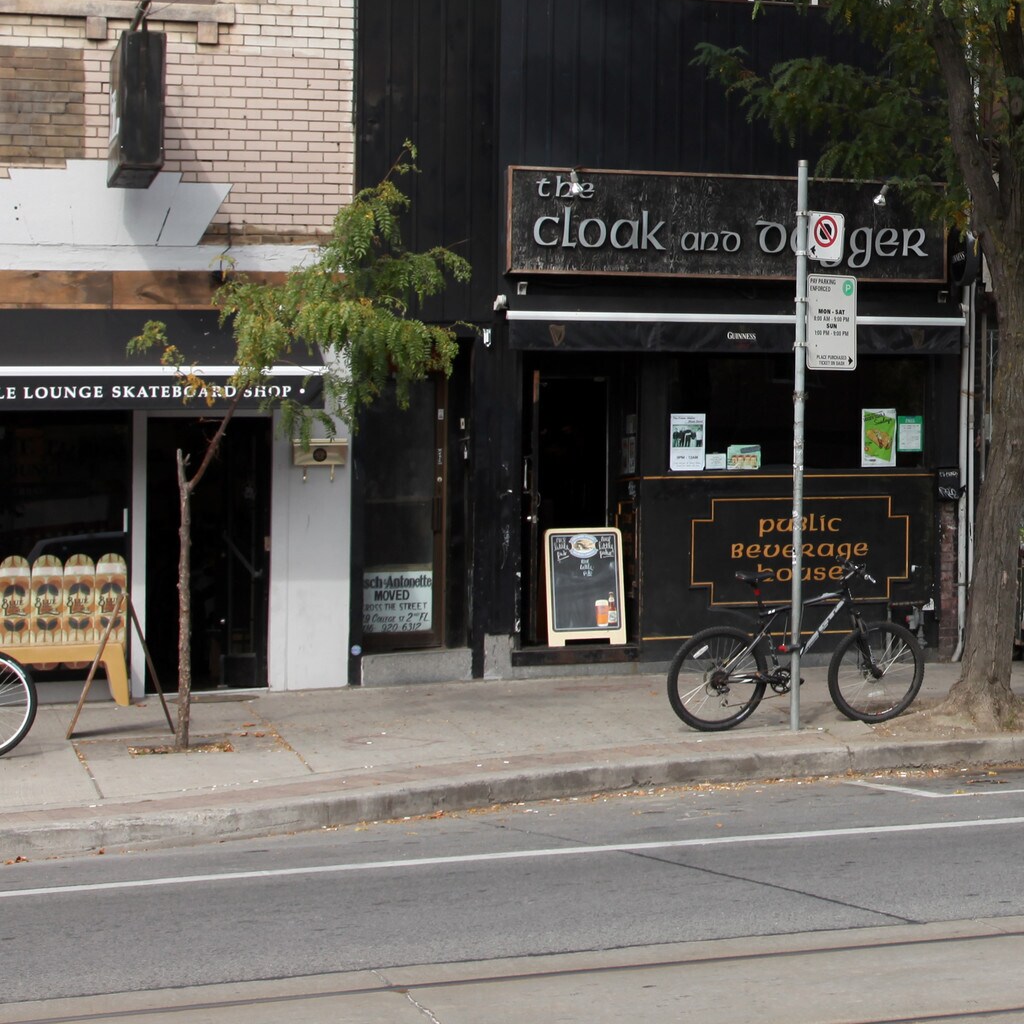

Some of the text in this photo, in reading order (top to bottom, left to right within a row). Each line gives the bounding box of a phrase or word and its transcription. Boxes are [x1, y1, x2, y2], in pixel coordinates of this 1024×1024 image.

[535, 175, 595, 199] the
[810, 285, 831, 293] ENFORCED
[23, 385, 104, 400] LOUNGE
[111, 385, 237, 399] SKATEBOARD
[243, 385, 292, 399] SHOP
[386, 574, 432, 588] Antonette
[374, 589, 410, 601] MOVED
[399, 602, 428, 610] STREET
[401, 623, 422, 631] 6312
